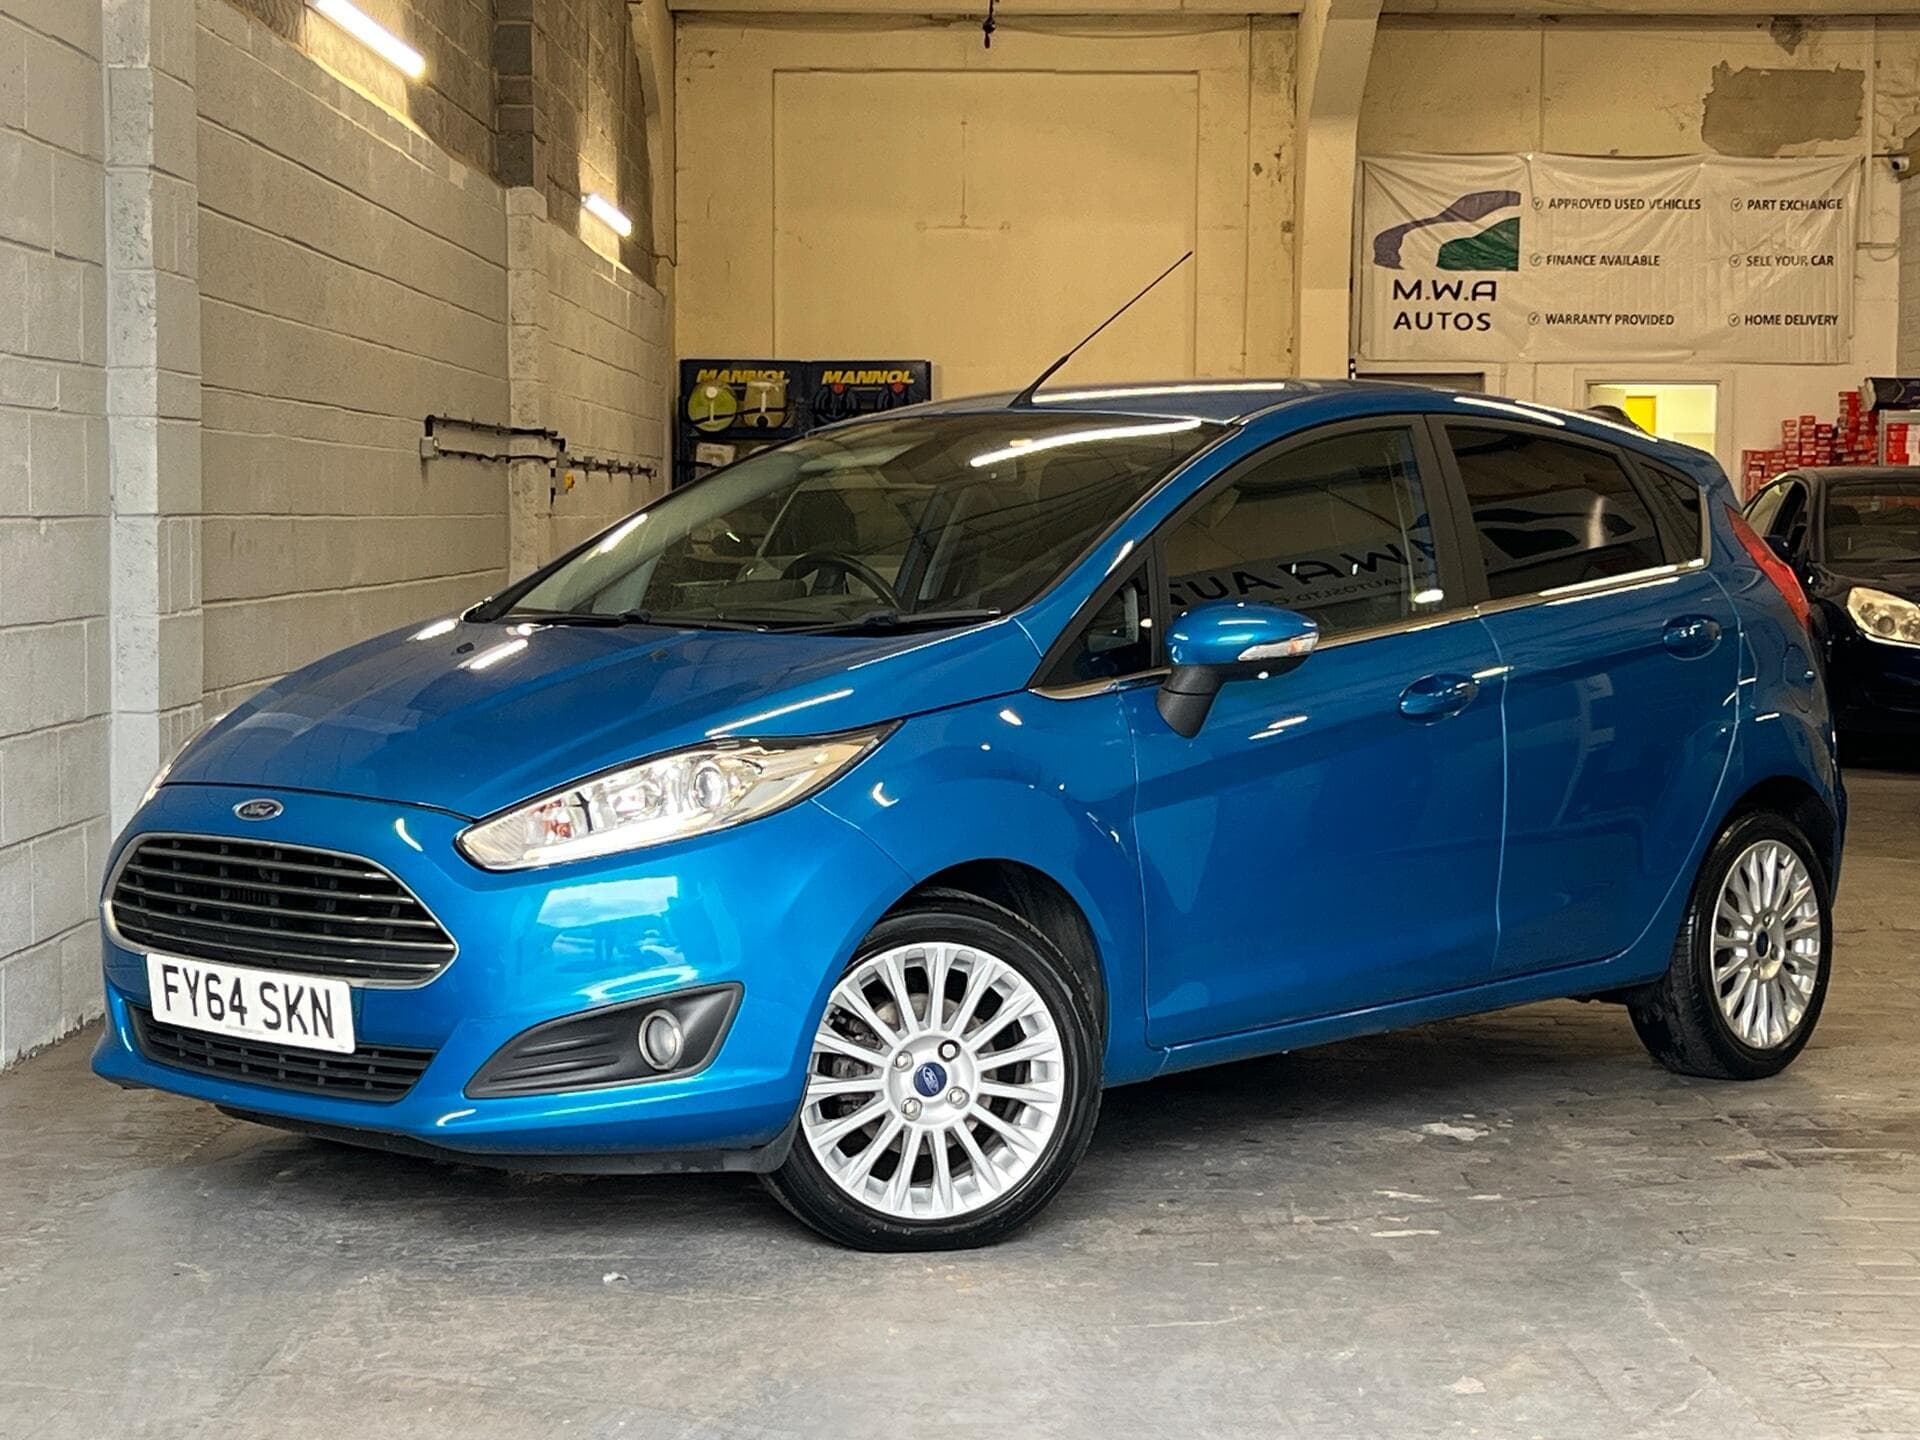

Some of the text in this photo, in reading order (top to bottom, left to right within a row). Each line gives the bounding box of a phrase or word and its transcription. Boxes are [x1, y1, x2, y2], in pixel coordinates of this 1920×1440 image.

[1548, 198, 1702, 210] APPROVED USED VEHICLES
[1747, 199, 1844, 211] PART EXCHANGE
[1546, 255, 1661, 266] FINANCE AVAILABLE
[1746, 255, 1835, 267] SELL YOUR CAR
[1393, 279, 1497, 301] M.W.A
[1393, 311, 1491, 331] AUTOS
[1545, 313, 1675, 325] WARRANTY PROVIDED
[1744, 314, 1839, 326] HOME DELIVERY
[821, 369, 915, 385] MANNOL
[161, 963, 335, 1039] FY64 SKN
